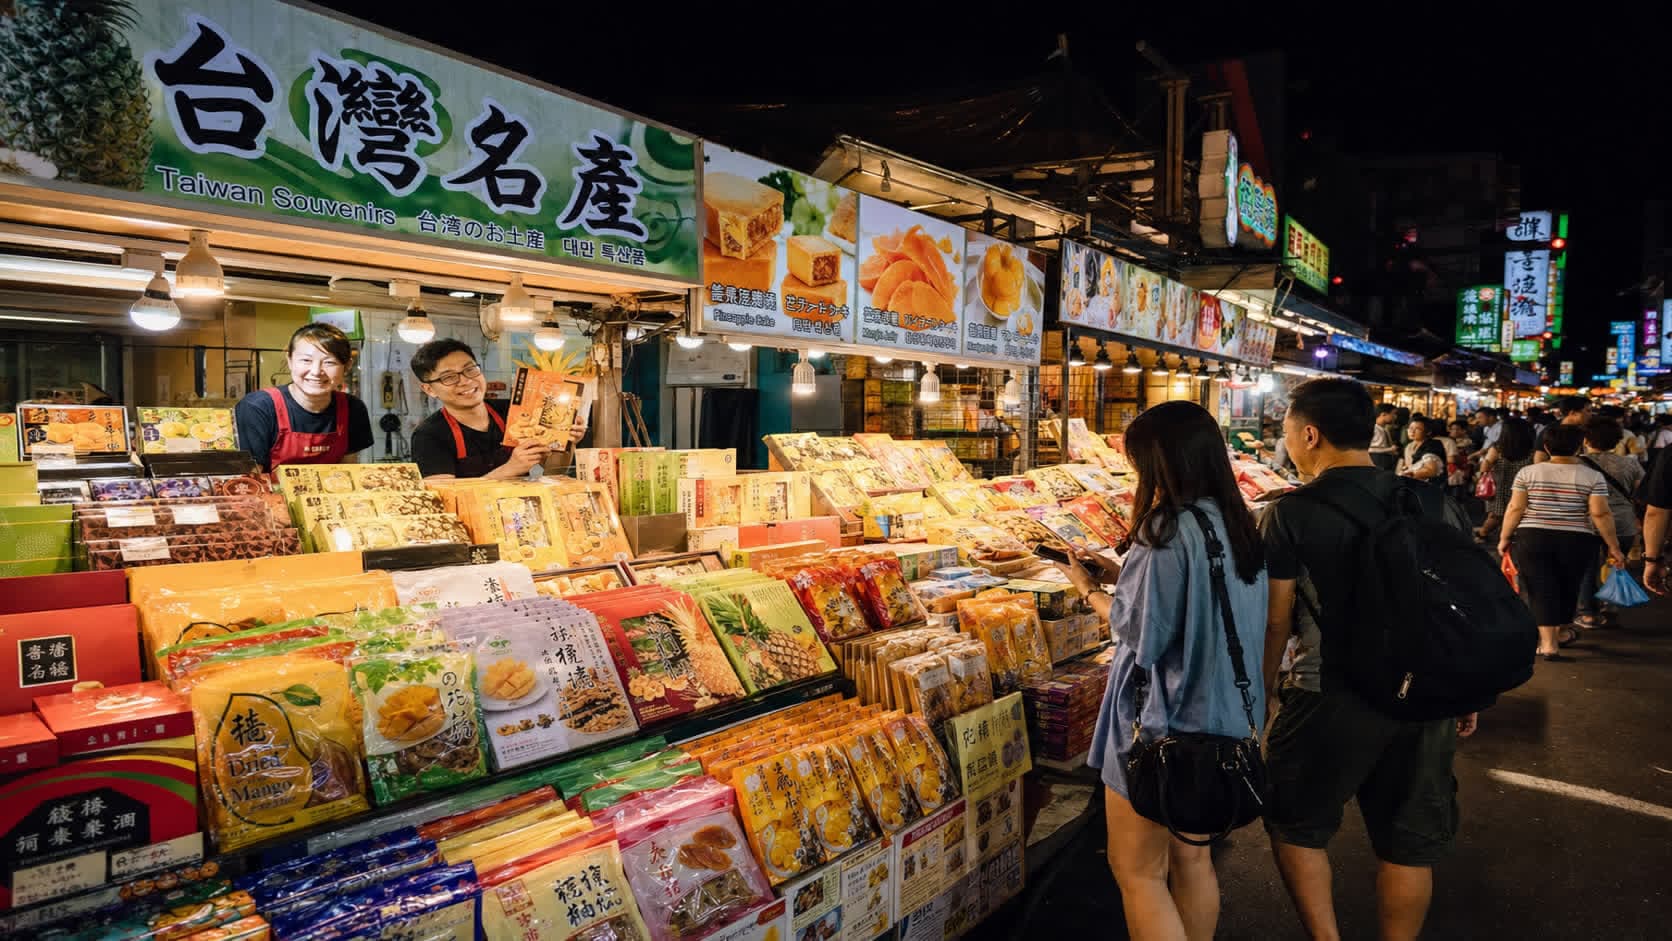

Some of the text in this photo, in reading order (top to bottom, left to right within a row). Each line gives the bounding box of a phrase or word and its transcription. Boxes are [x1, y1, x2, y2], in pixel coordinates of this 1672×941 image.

[154, 20, 647, 238] 台灣名產
[155, 166, 396, 225] Taiwan Souvenirs
[417, 210, 545, 249] 台湾のお土産
[563, 238, 646, 266] 대만 특산품
[228, 751, 281, 777] Dried
[231, 780, 293, 801] Mango
